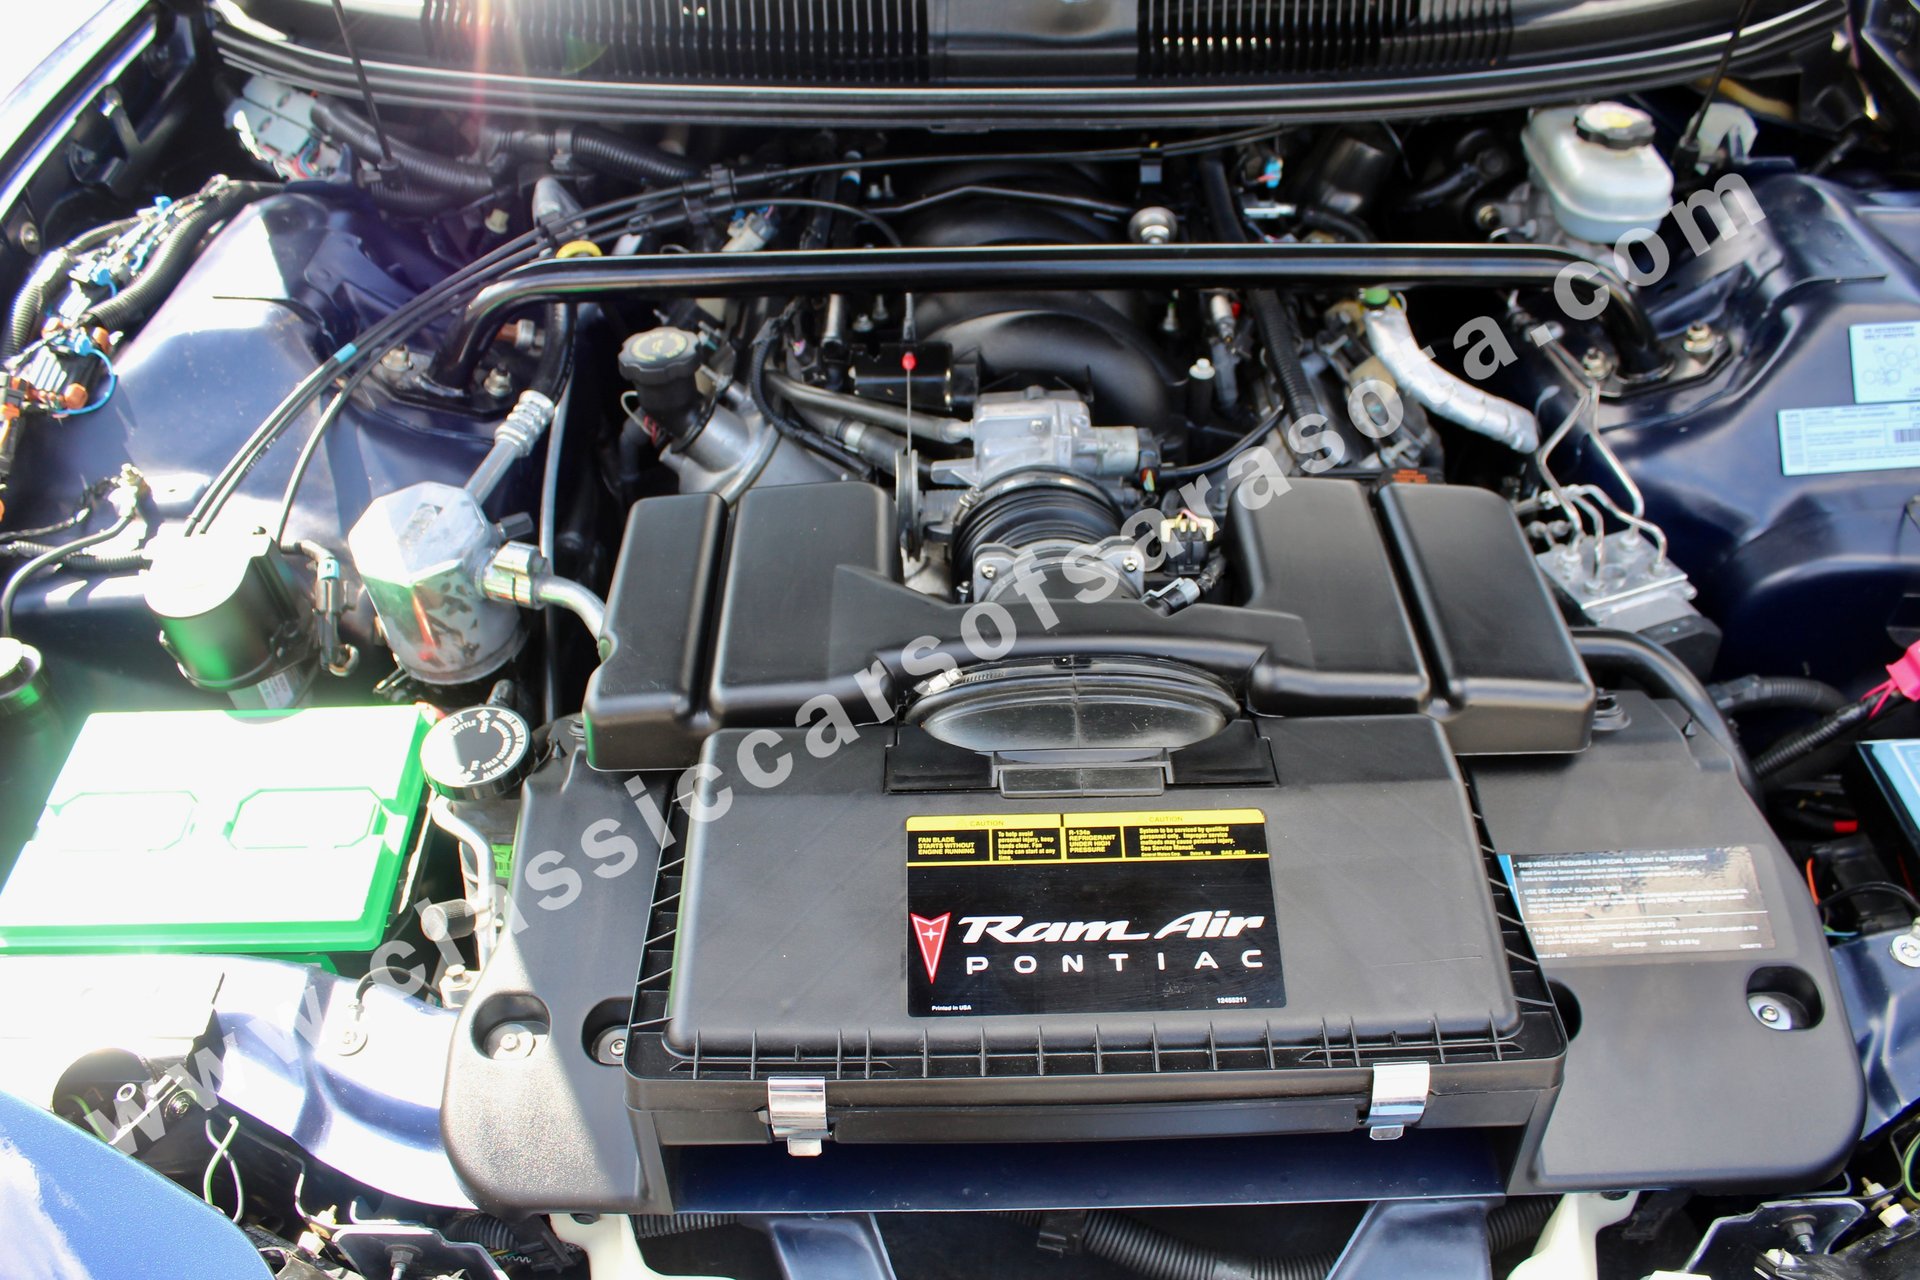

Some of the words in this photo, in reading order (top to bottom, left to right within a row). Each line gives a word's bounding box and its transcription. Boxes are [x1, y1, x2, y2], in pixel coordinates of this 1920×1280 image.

[958, 915, 1149, 944] Ram
[1154, 909, 1265, 940] Air
[966, 949, 1264, 975] PONTIAC
